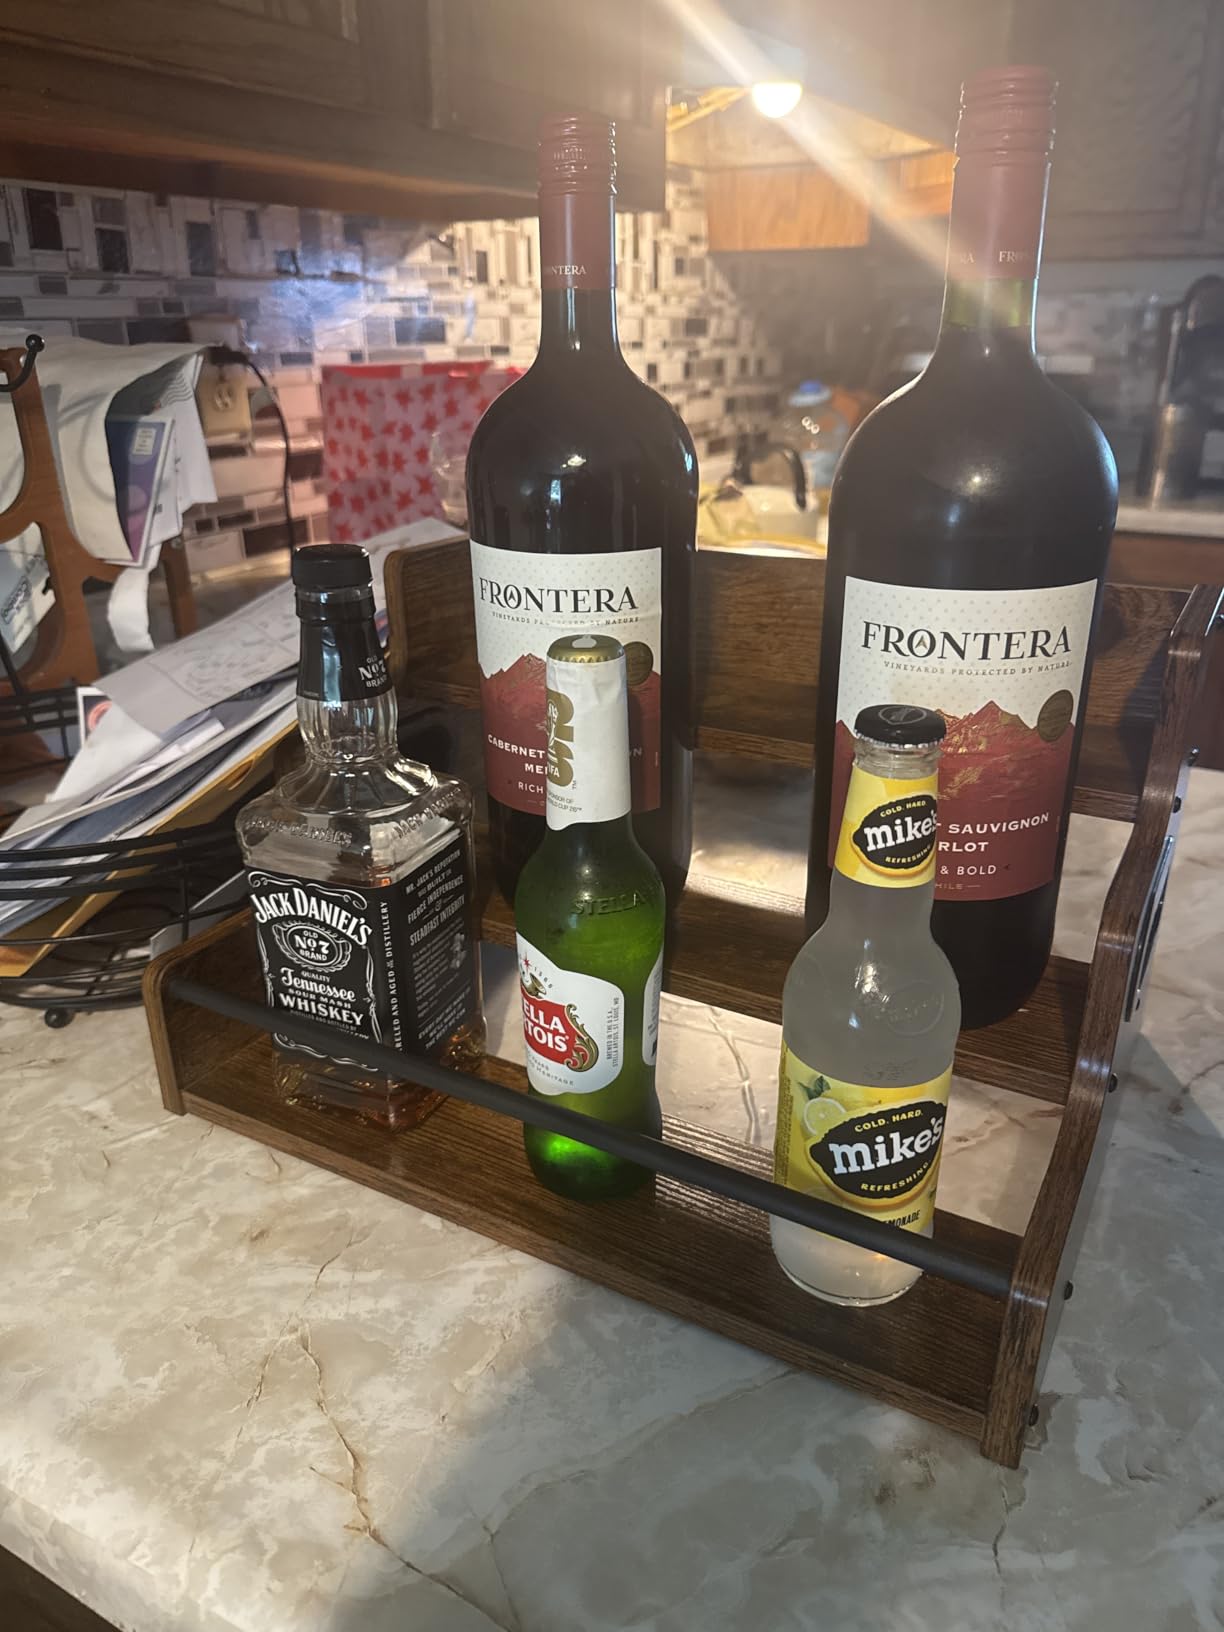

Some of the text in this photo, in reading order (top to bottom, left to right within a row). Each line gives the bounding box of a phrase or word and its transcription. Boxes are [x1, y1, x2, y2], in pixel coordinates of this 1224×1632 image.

[479, 576, 639, 613] FRONTERA
[861, 620, 1072, 661] FRONTERA
[884, 660, 945, 675] VINEYARDS
[951, 667, 1016, 676] PROTECTED
[1021, 665, 1034, 674] BY
[487, 733, 546, 760] CABERNET
[517, 781, 544, 794] RICH
[948, 811, 1050, 834] SAUVIGNON
[940, 864, 997, 875] & BOLD
[250, 887, 373, 946] JACK DANIEL'S
[407, 899, 428, 925] FIERCE
[303, 930, 319, 939] OLD
[380, 901, 393, 958] DISTILLERY
[409, 914, 440, 947] STEADFAST
[299, 948, 328, 961] BRAND
[280, 967, 357, 1002] Tennessee
[300, 970, 331, 983] QUALITY
[387, 970, 397, 995] AGED
[279, 992, 364, 1026] WHISKEY
[288, 988, 352, 1009] SOUR MASH
[390, 997, 400, 1016] AND
[524, 1018, 570, 1053] TOIS
[828, 1116, 944, 1175] mike's
[860, 1161, 929, 1192] REFRESHING
